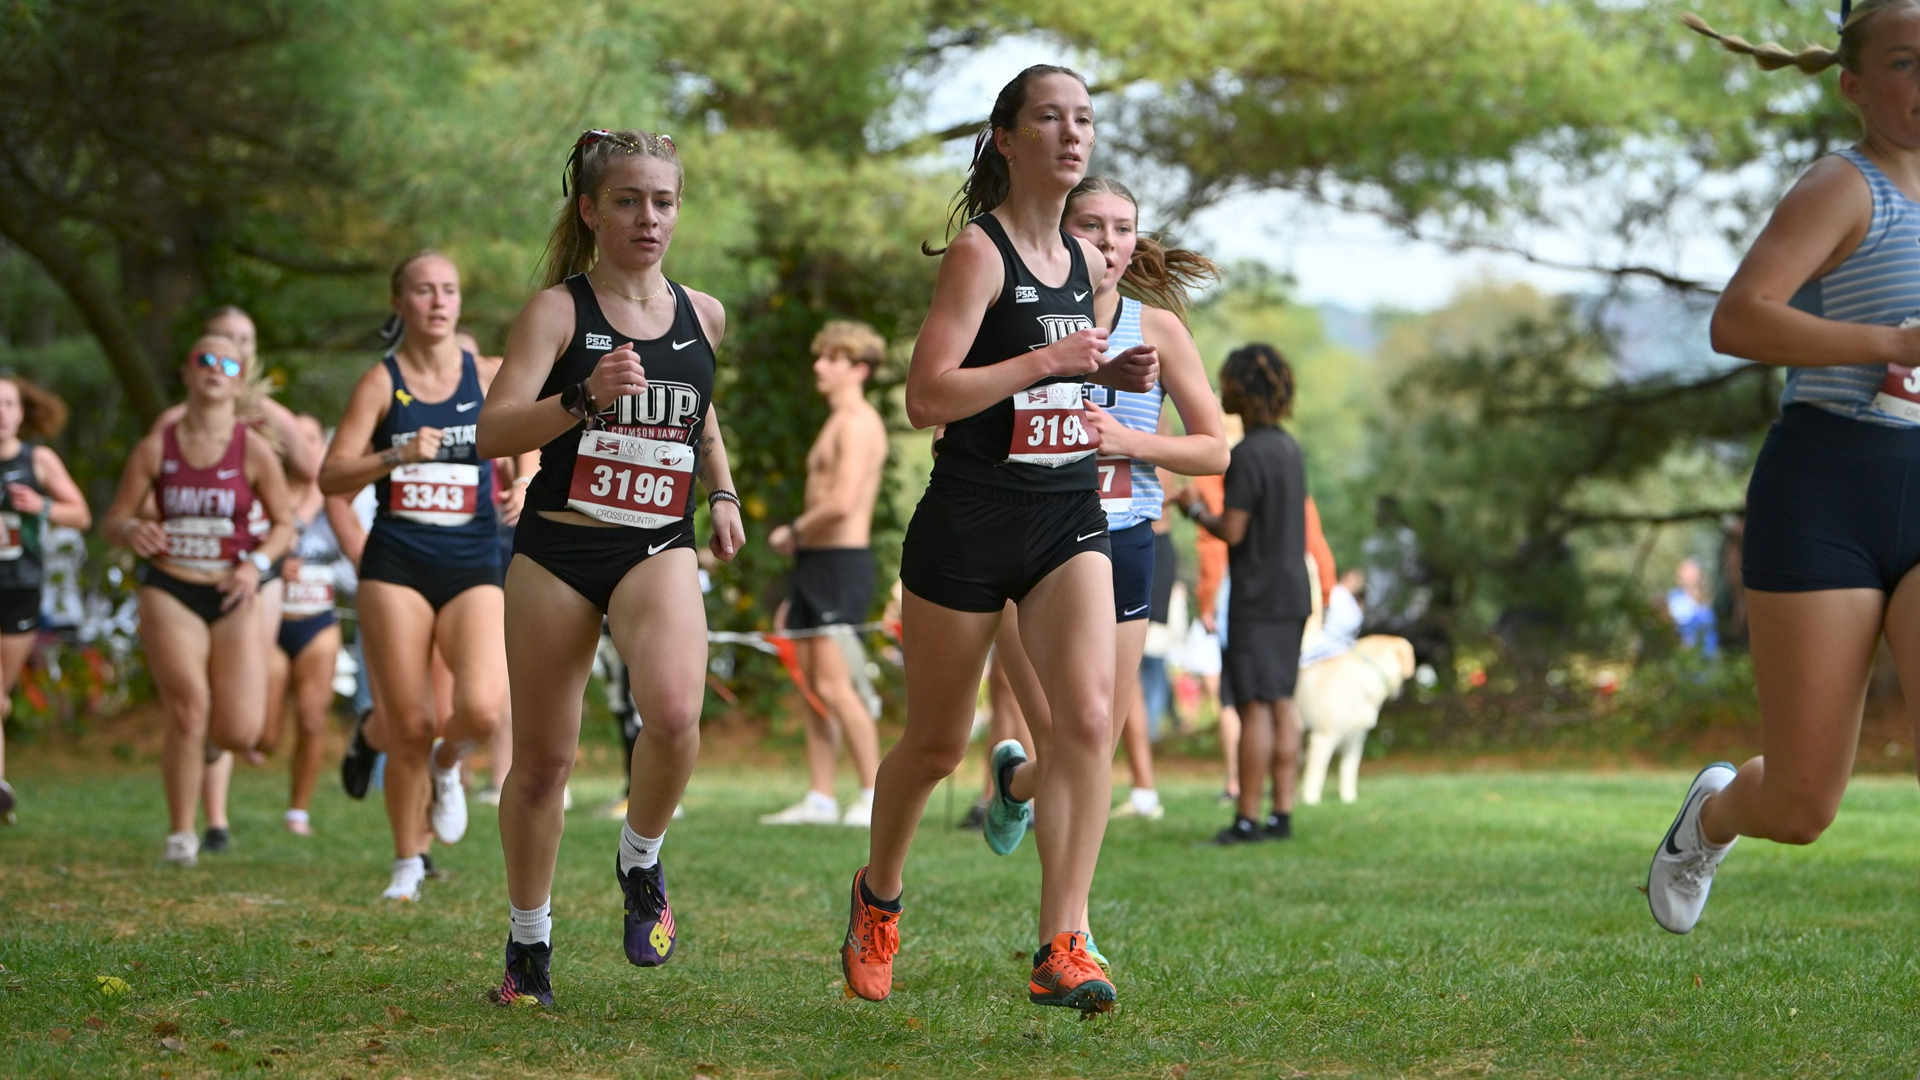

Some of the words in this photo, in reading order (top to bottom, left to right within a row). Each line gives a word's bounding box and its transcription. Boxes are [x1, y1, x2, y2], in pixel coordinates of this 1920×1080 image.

[1016, 290, 1038, 299] PSAC
[586, 337, 612, 347] PSAC
[611, 426, 654, 439] CRIMSON
[621, 440, 643, 450] LOCK
[590, 464, 675, 507] 3196
[401, 483, 465, 510] 3343
[596, 508, 623, 521] CROSS
[622, 513, 658, 526] COUNTRY
